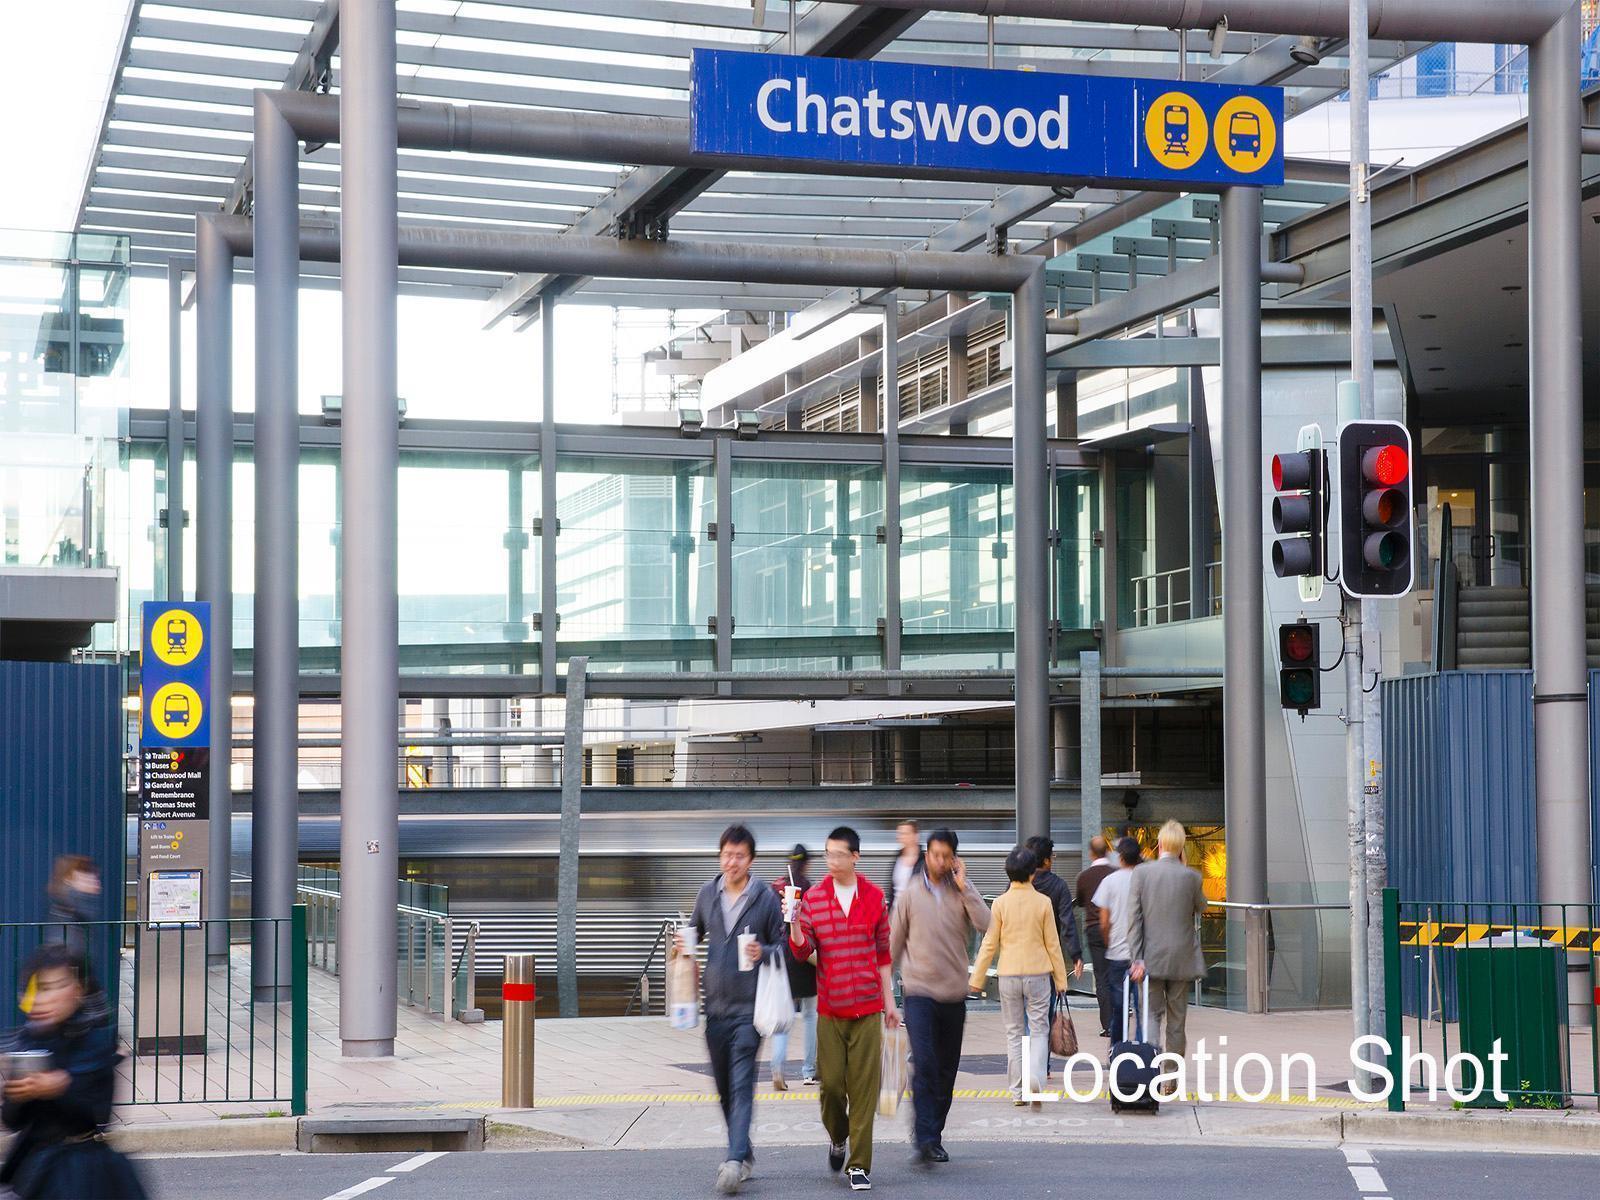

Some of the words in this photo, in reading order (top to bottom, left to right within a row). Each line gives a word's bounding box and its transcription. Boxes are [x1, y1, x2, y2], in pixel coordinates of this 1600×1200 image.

[756, 78, 1069, 150] Chatswood
[151, 752, 171, 760] Trains
[151, 771, 187, 779] Chatswood
[187, 771, 202, 779] Mall
[151, 781, 175, 789] Garden
[175, 781, 183, 789] of
[150, 791, 195, 799] Remembrance
[988, 1117, 1124, 1128] LOOK
